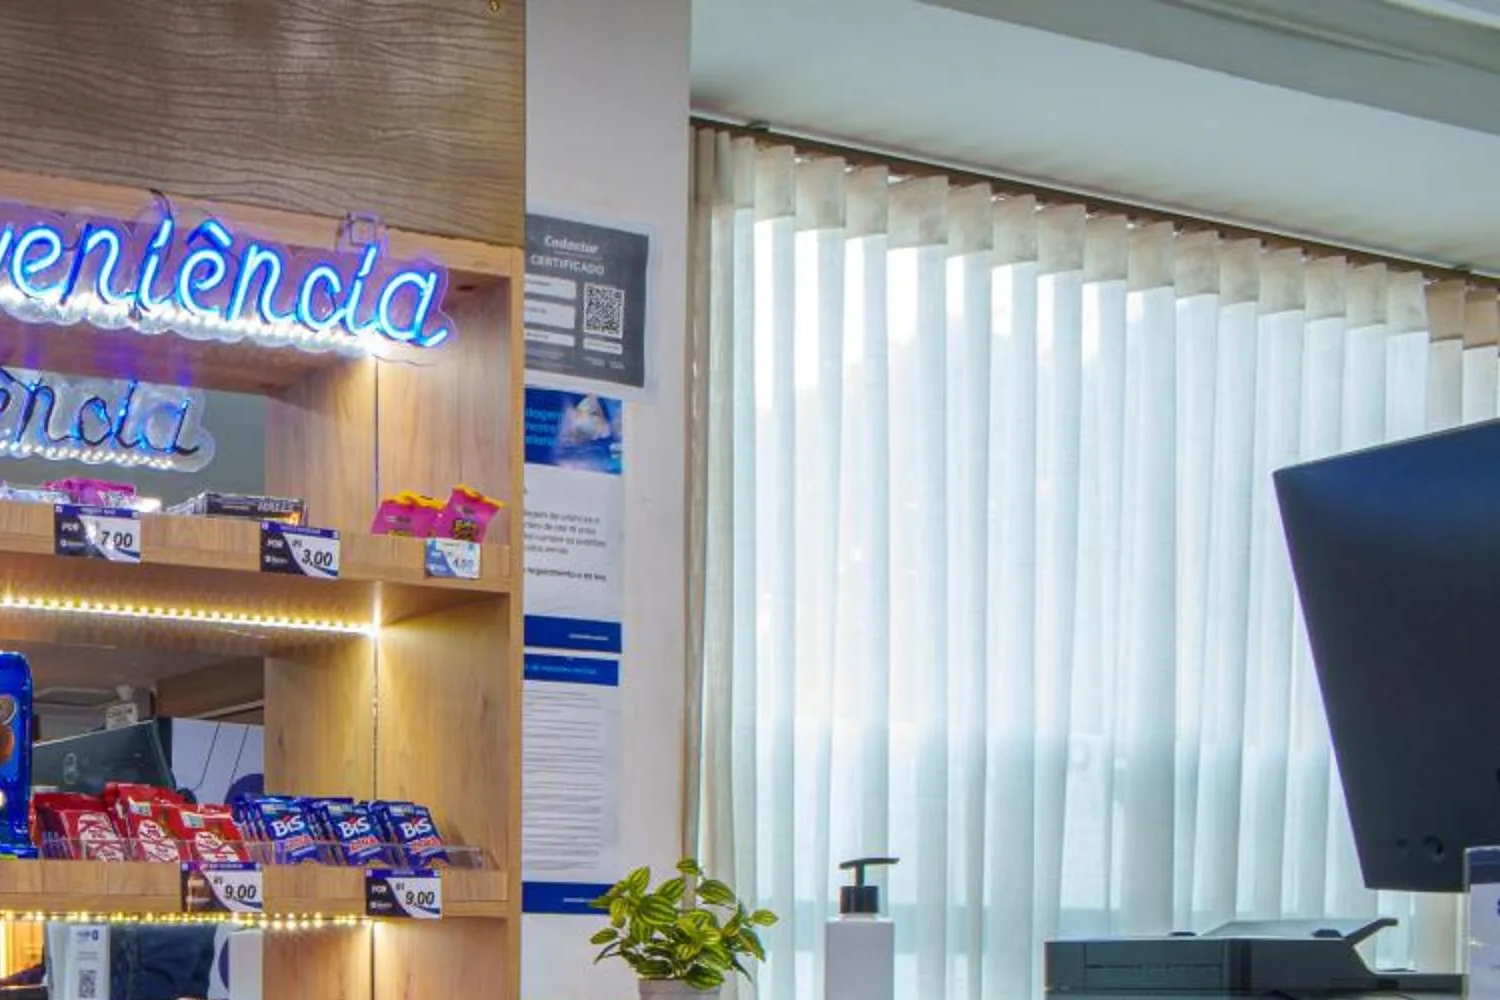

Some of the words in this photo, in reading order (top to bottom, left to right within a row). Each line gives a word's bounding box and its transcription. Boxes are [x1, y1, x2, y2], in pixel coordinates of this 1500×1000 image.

[530, 253, 605, 275] CERTIFICADO
[61, 521, 80, 532] POR
[101, 531, 133, 548] 700
[267, 539, 284, 548] POR
[301, 549, 333, 567] 3,00
[223, 884, 257, 900] 9,00
[371, 885, 388, 894] POR
[404, 891, 436, 905] 9,00
